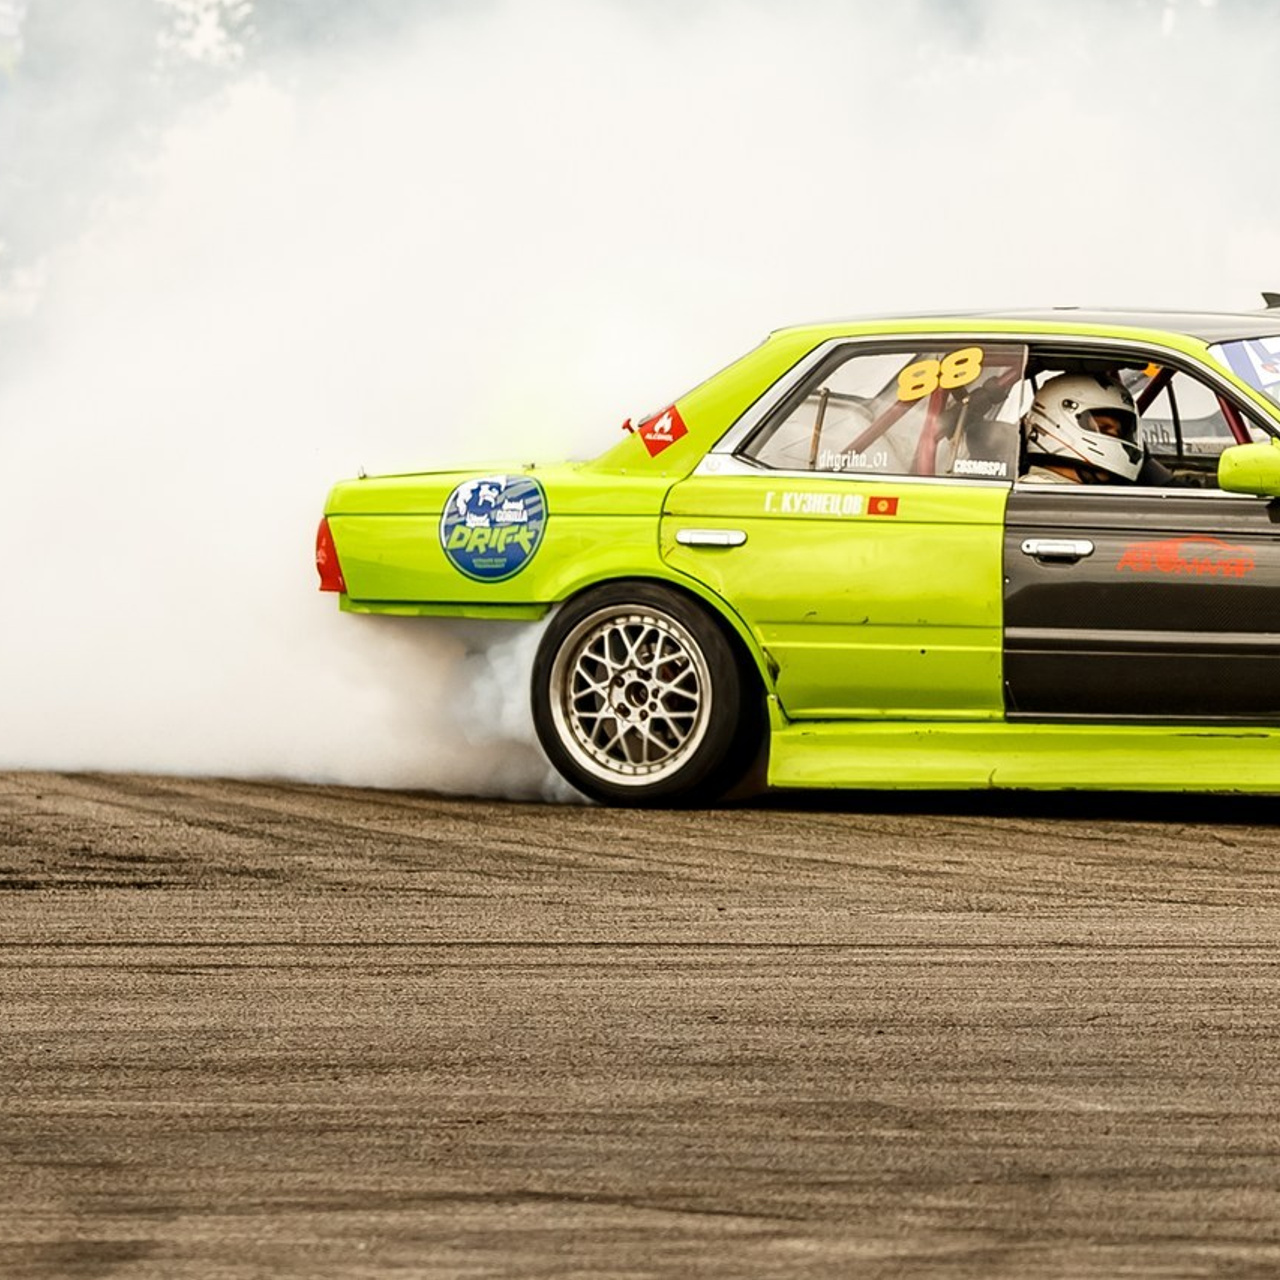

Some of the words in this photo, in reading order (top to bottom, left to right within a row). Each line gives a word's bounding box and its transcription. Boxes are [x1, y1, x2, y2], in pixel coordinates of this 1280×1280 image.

[896, 346, 984, 402] 88
[781, 493, 863, 515] КУЗНЕЦОВ
[447, 524, 536, 555] DRIFT
